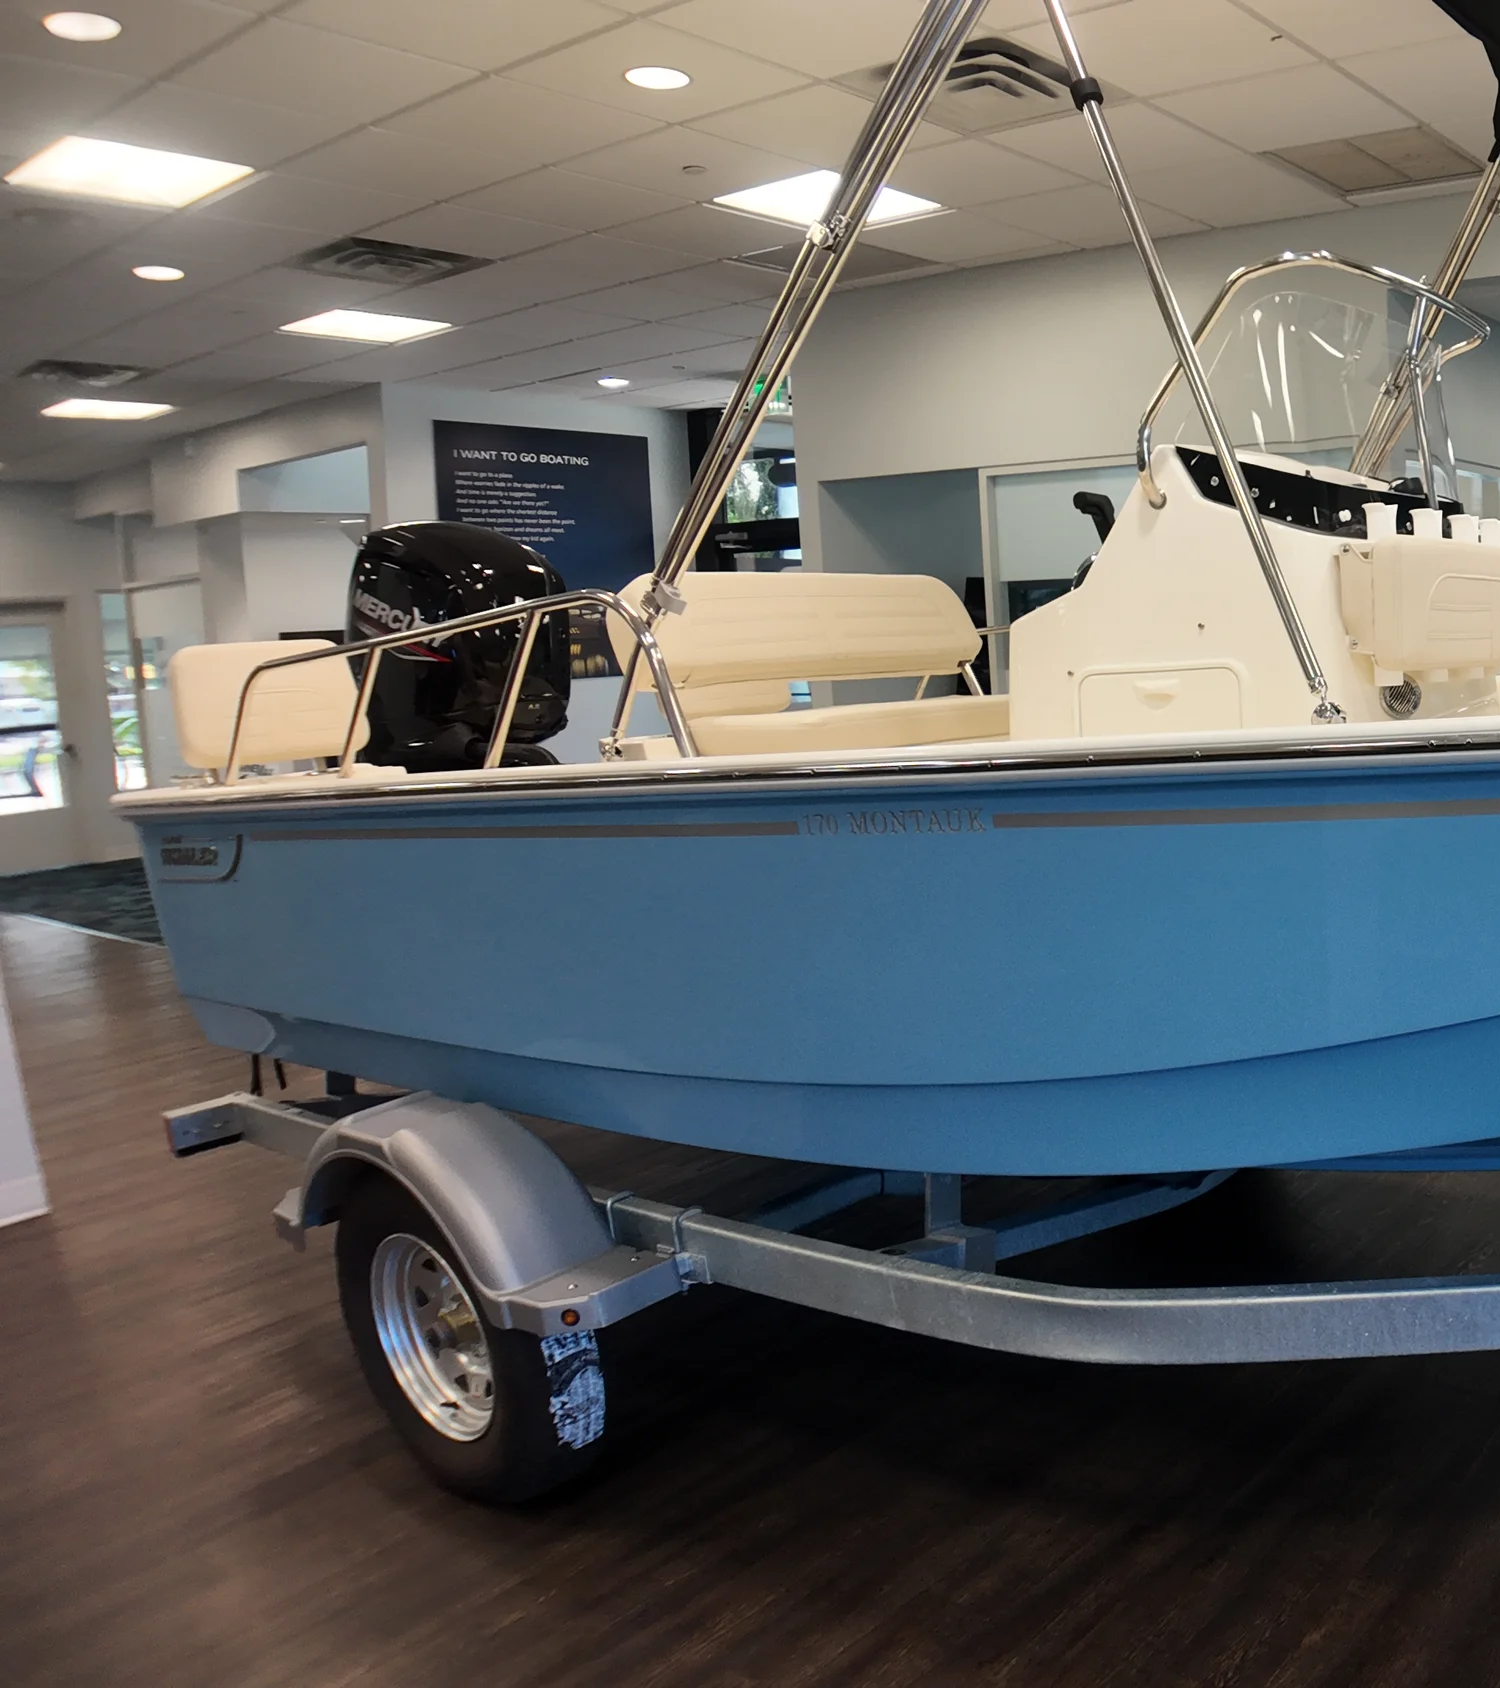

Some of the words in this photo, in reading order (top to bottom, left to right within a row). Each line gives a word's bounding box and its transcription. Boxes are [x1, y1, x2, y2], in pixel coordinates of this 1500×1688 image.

[459, 449, 498, 460] WANT
[500, 451, 518, 462] TO
[519, 452, 538, 463] GO
[539, 454, 590, 466] BOATING
[802, 813, 839, 836] 170
[846, 807, 987, 835] MONTAUK
